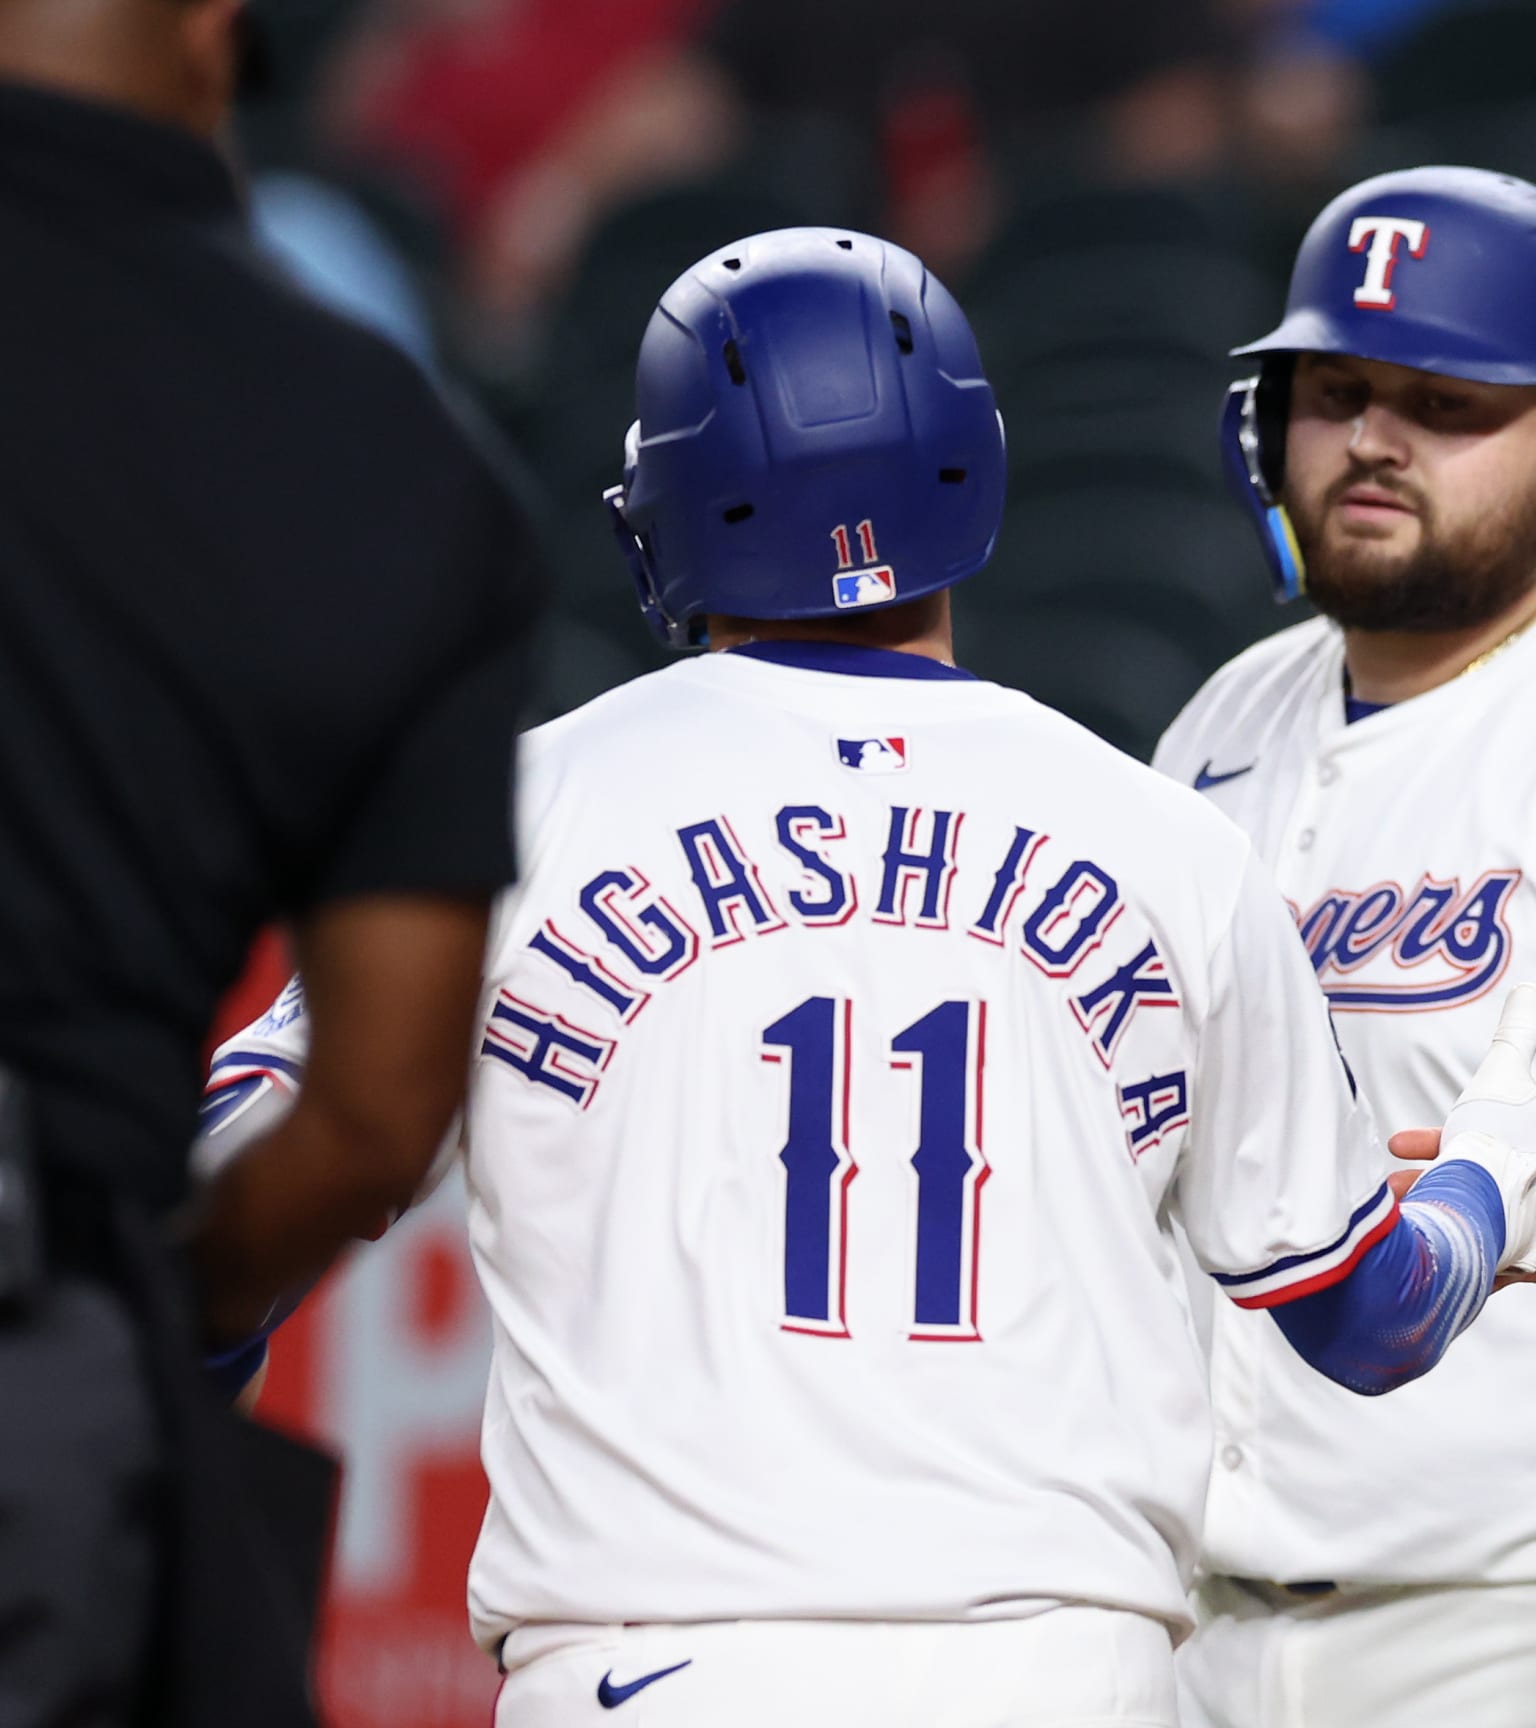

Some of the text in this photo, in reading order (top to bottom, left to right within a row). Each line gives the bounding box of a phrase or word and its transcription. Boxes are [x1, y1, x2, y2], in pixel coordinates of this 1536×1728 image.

[1348, 216, 1431, 312] T
[830, 518, 879, 570] 11
[480, 804, 1190, 1165] HIGASHIOKA
[1283, 868, 1522, 1013] gers
[760, 996, 992, 1342] 11
